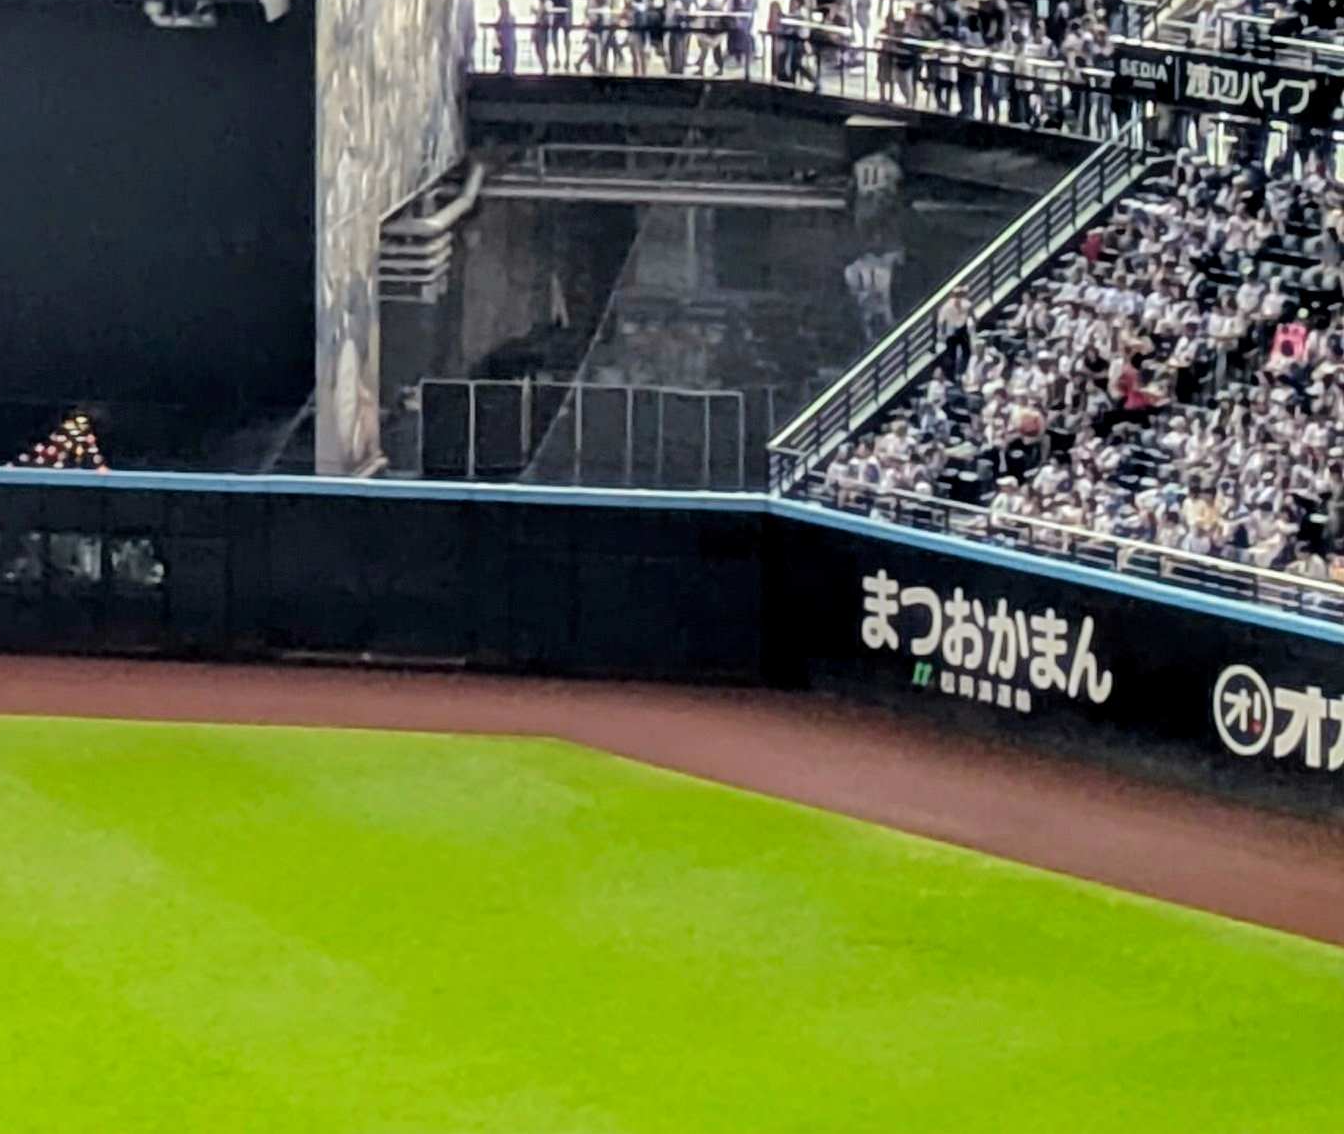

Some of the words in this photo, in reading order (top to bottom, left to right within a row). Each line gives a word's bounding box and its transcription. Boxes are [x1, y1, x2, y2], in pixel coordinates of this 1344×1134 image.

[861, 569, 1114, 705] まつおかまん
